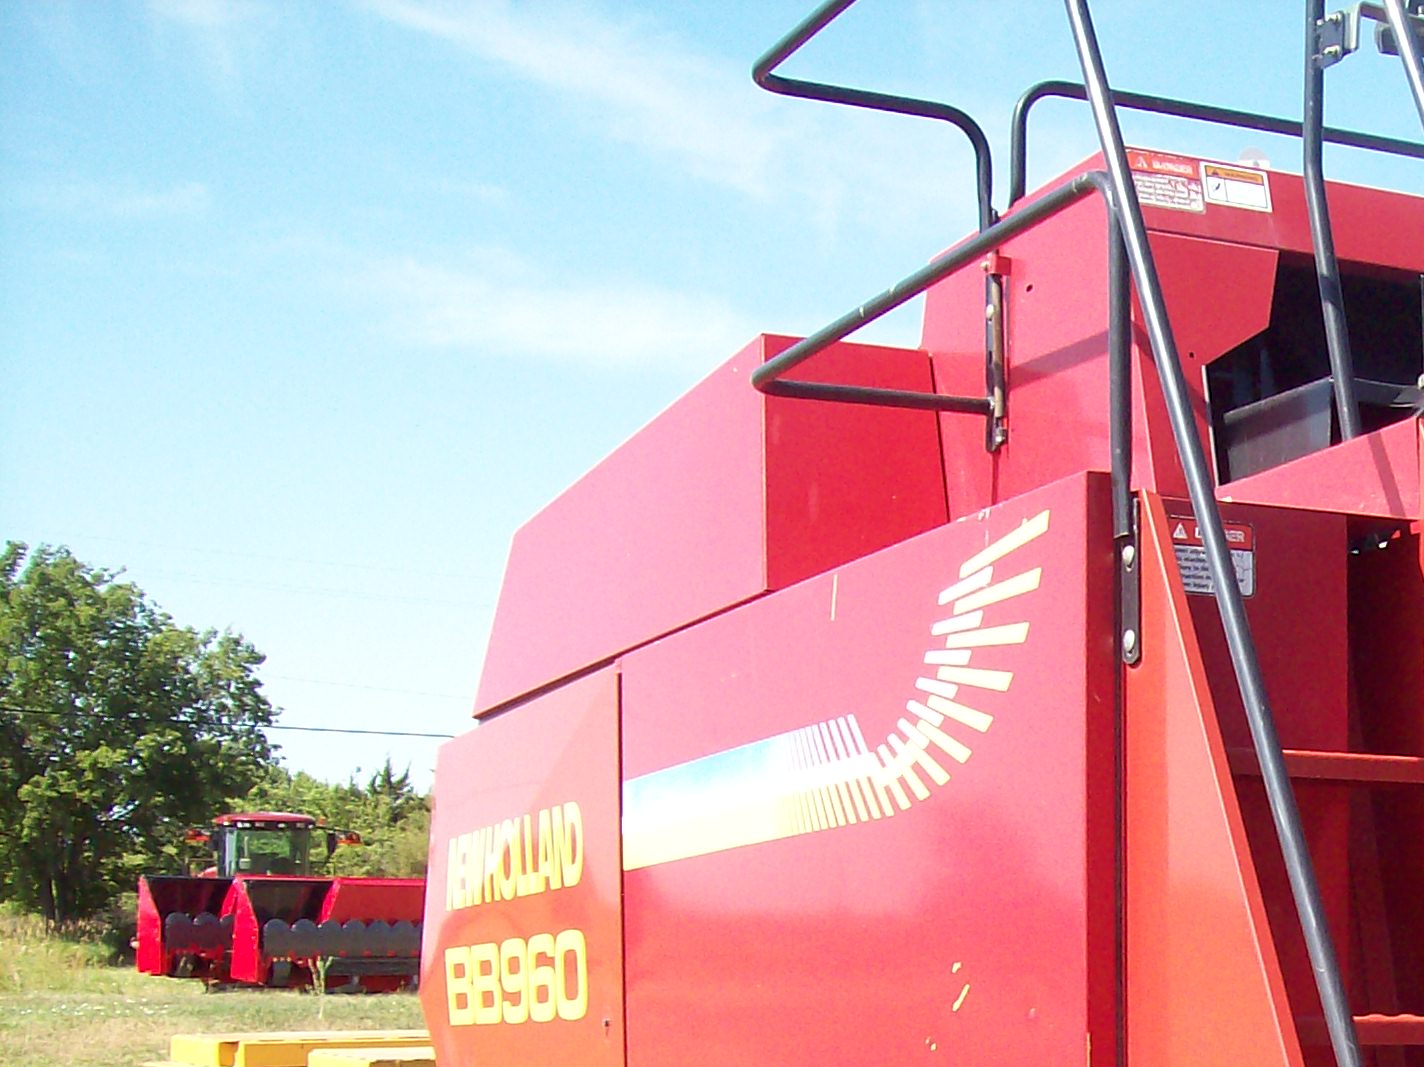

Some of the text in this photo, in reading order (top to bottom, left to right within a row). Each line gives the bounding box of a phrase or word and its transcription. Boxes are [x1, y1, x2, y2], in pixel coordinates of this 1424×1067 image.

[446, 801, 583, 911] NEW HOLLAND
[445, 929, 587, 1026] BB960
